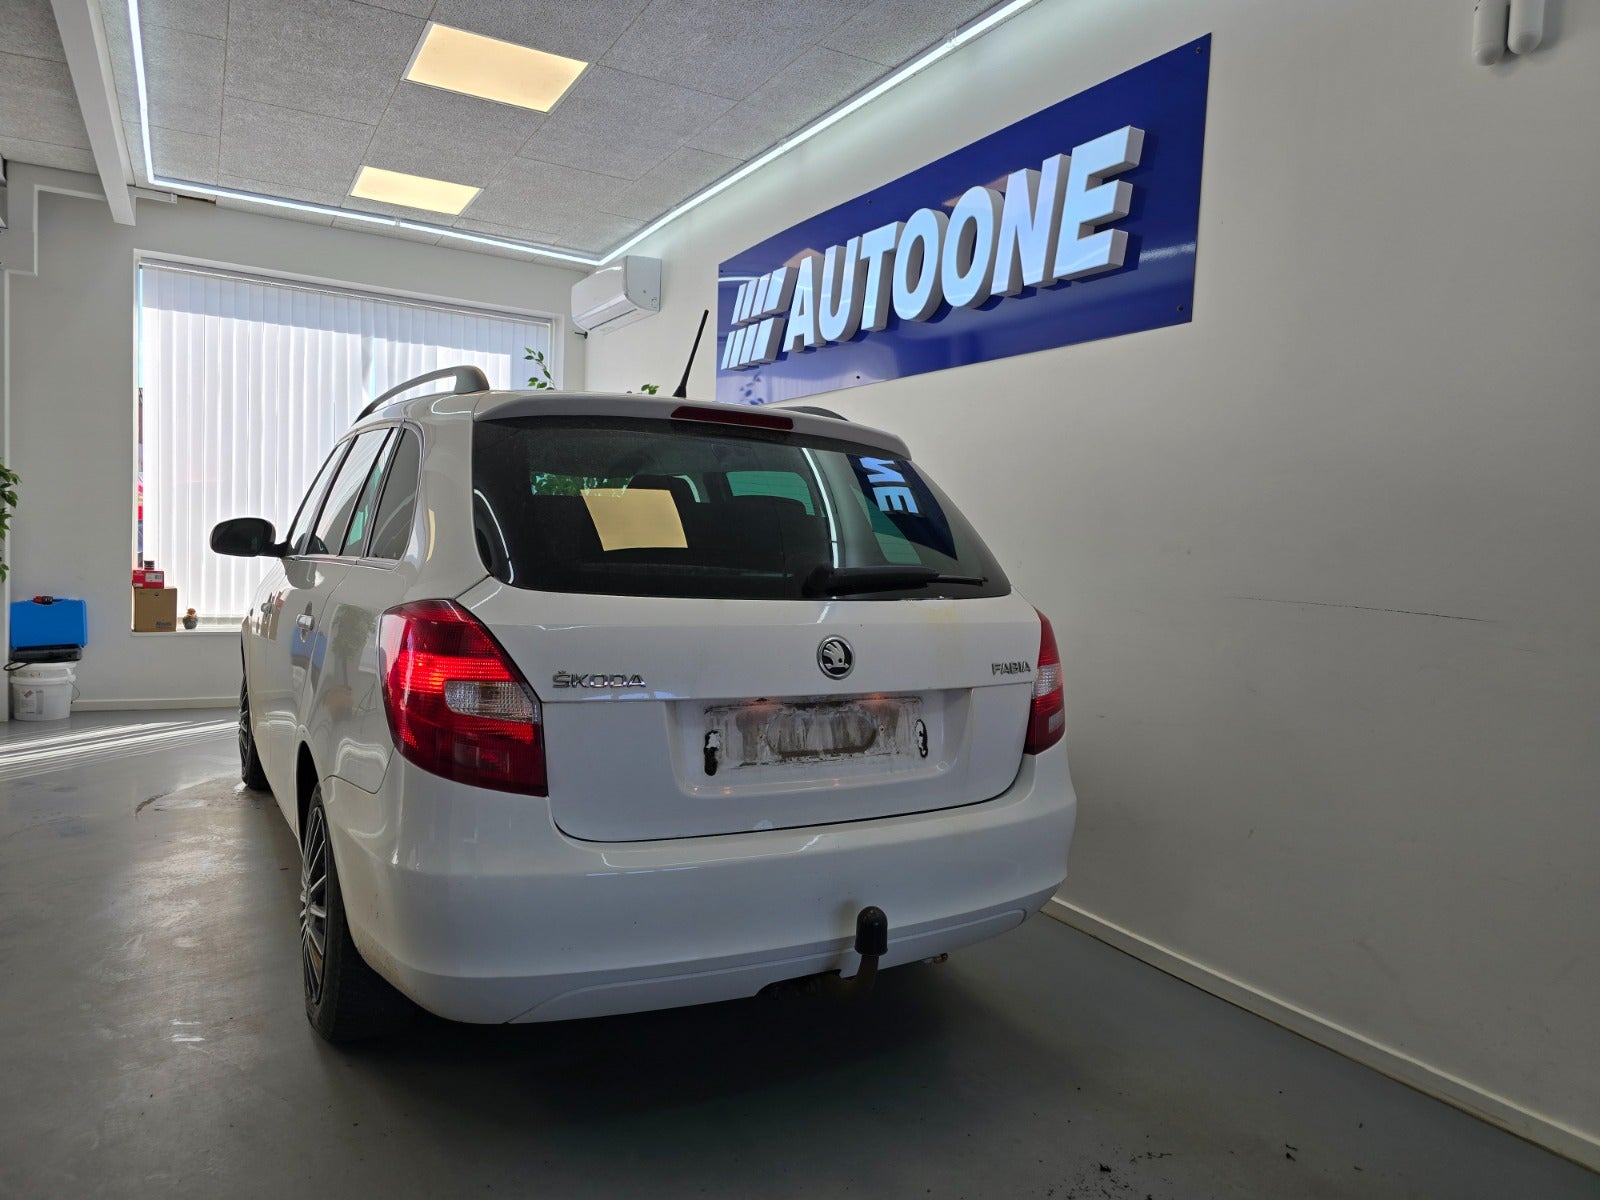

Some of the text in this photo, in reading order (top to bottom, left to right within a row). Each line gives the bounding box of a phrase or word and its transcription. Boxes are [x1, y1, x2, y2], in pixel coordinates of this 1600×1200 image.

[783, 125, 1145, 354] AUTOONE
[991, 661, 1031, 675] FABIA
[552, 670, 646, 688] ŠKODA
